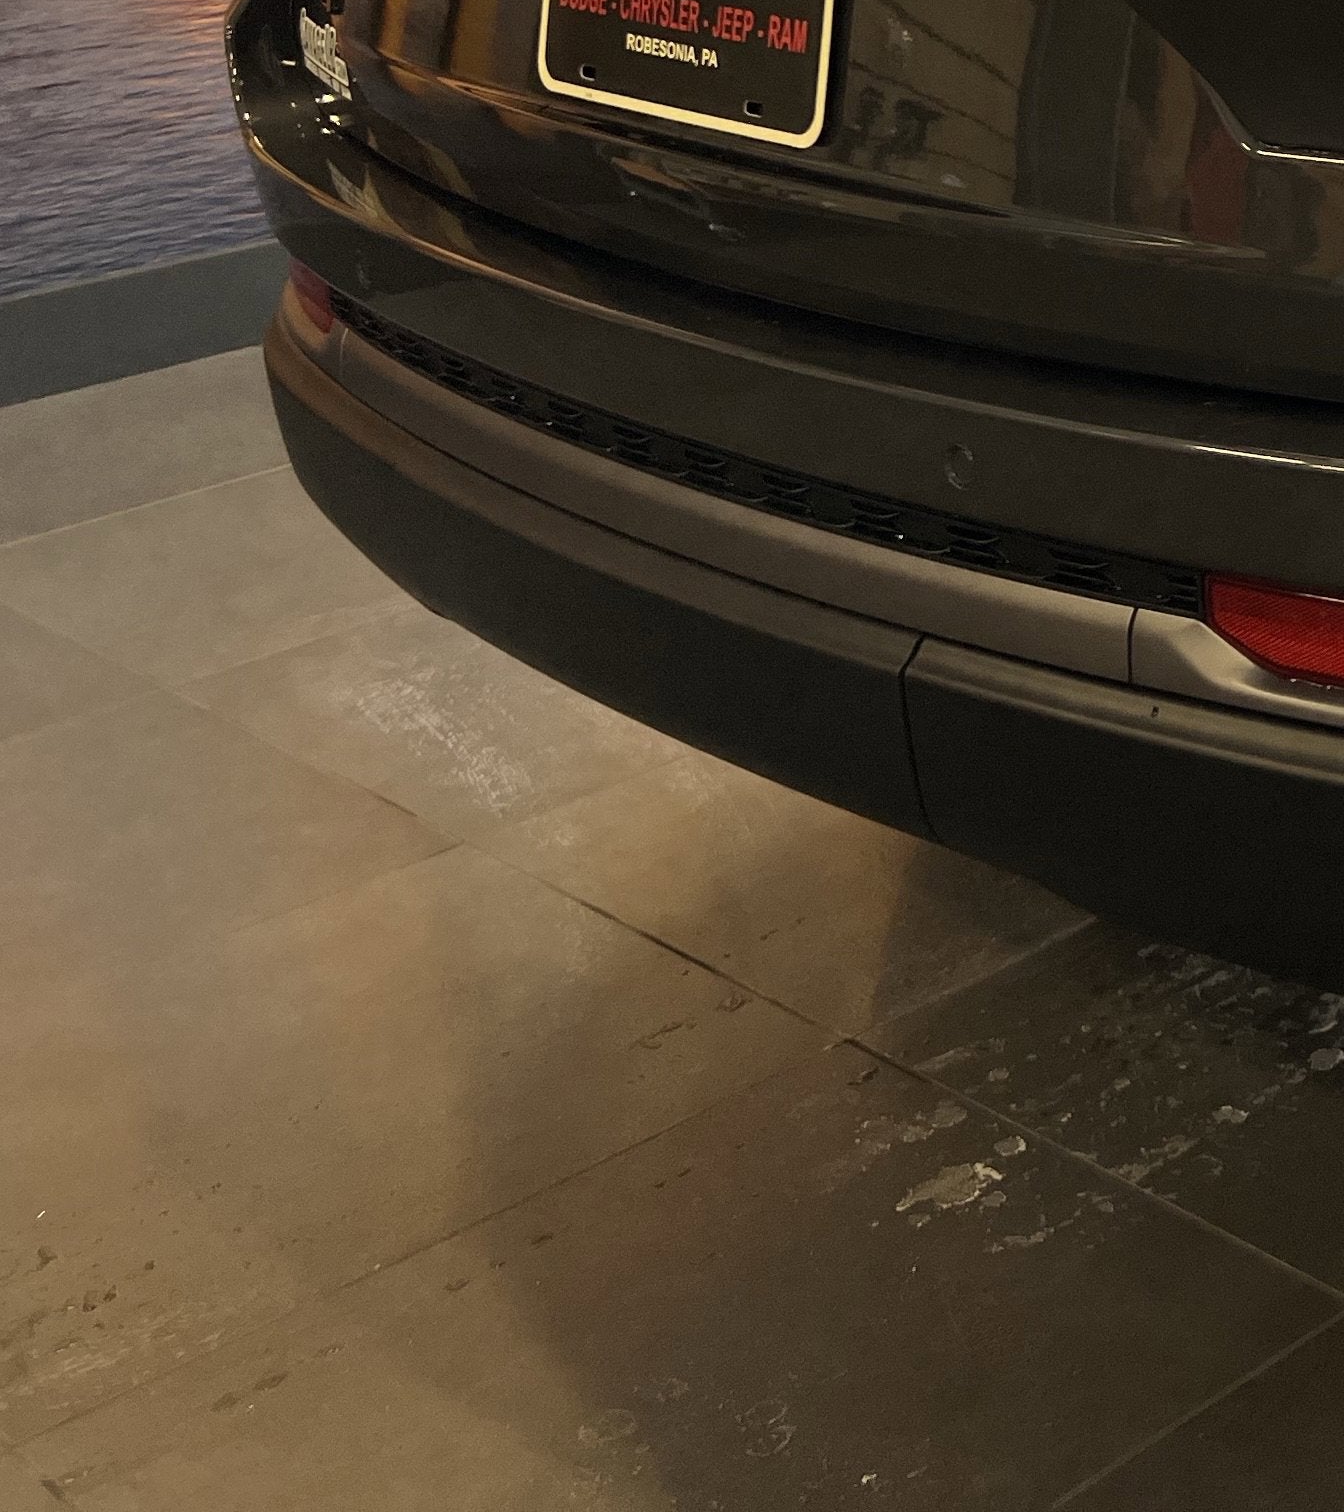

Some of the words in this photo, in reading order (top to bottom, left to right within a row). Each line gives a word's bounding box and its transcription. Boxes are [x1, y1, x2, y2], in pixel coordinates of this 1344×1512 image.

[626, 33, 699, 66] ROBESONIA,
[701, 48, 719, 68] PA
[711, 6, 756, 42] JEEP
[767, 14, 810, 54] RAM
